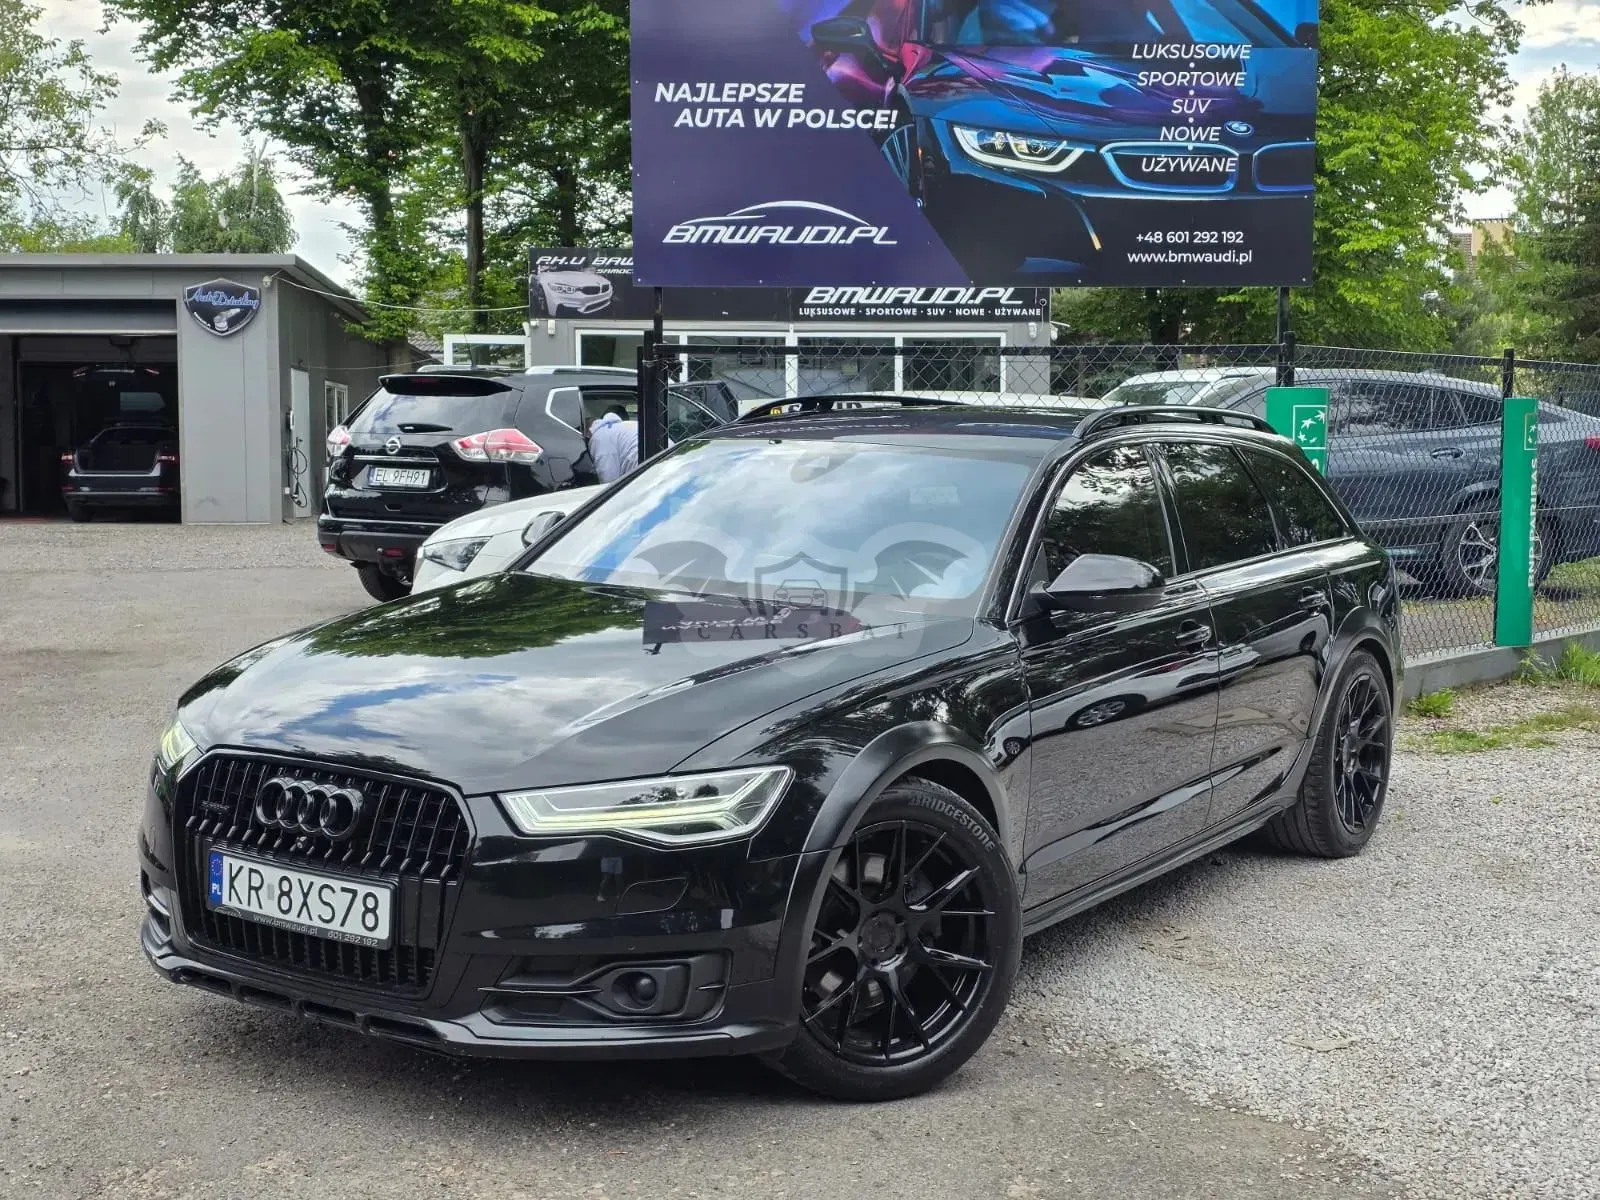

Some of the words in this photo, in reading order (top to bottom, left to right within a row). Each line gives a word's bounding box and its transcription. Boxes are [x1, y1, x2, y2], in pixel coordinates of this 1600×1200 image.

[1131, 44, 1252, 59] LUKSUSOWE
[1136, 71, 1247, 86] SPORTOWE
[654, 82, 805, 103] NAJLEPSZE
[1171, 99, 1211, 114] SUV
[673, 108, 745, 128] AUTA
[753, 108, 783, 128] W
[787, 109, 898, 130] POLSCE!
[1160, 126, 1221, 141] NOWE
[1141, 154, 1238, 172] UŻYWANE
[662, 225, 898, 245] BMWAUDI.PL
[1136, 231, 1163, 244] +48
[1166, 231, 1189, 244] 601
[1193, 231, 1218, 244] 292
[1221, 231, 1244, 244] 192
[1127, 250, 1252, 265] www.bmwaudi.pl
[803, 287, 1024, 304] BMWAUDI.PL
[799, 307, 856, 316] LUKSUSOWE
[865, 307, 918, 316] SPORTOWE
[926, 307, 945, 316] SUV
[955, 307, 985, 316] NOWE
[994, 306, 1041, 316] UŻYWANE
[376, 468, 387, 482] EL
[393, 470, 426, 484] 9FH91
[211, 883, 222, 896] PL
[229, 862, 265, 909] KR
[277, 874, 380, 932] 8XS78
